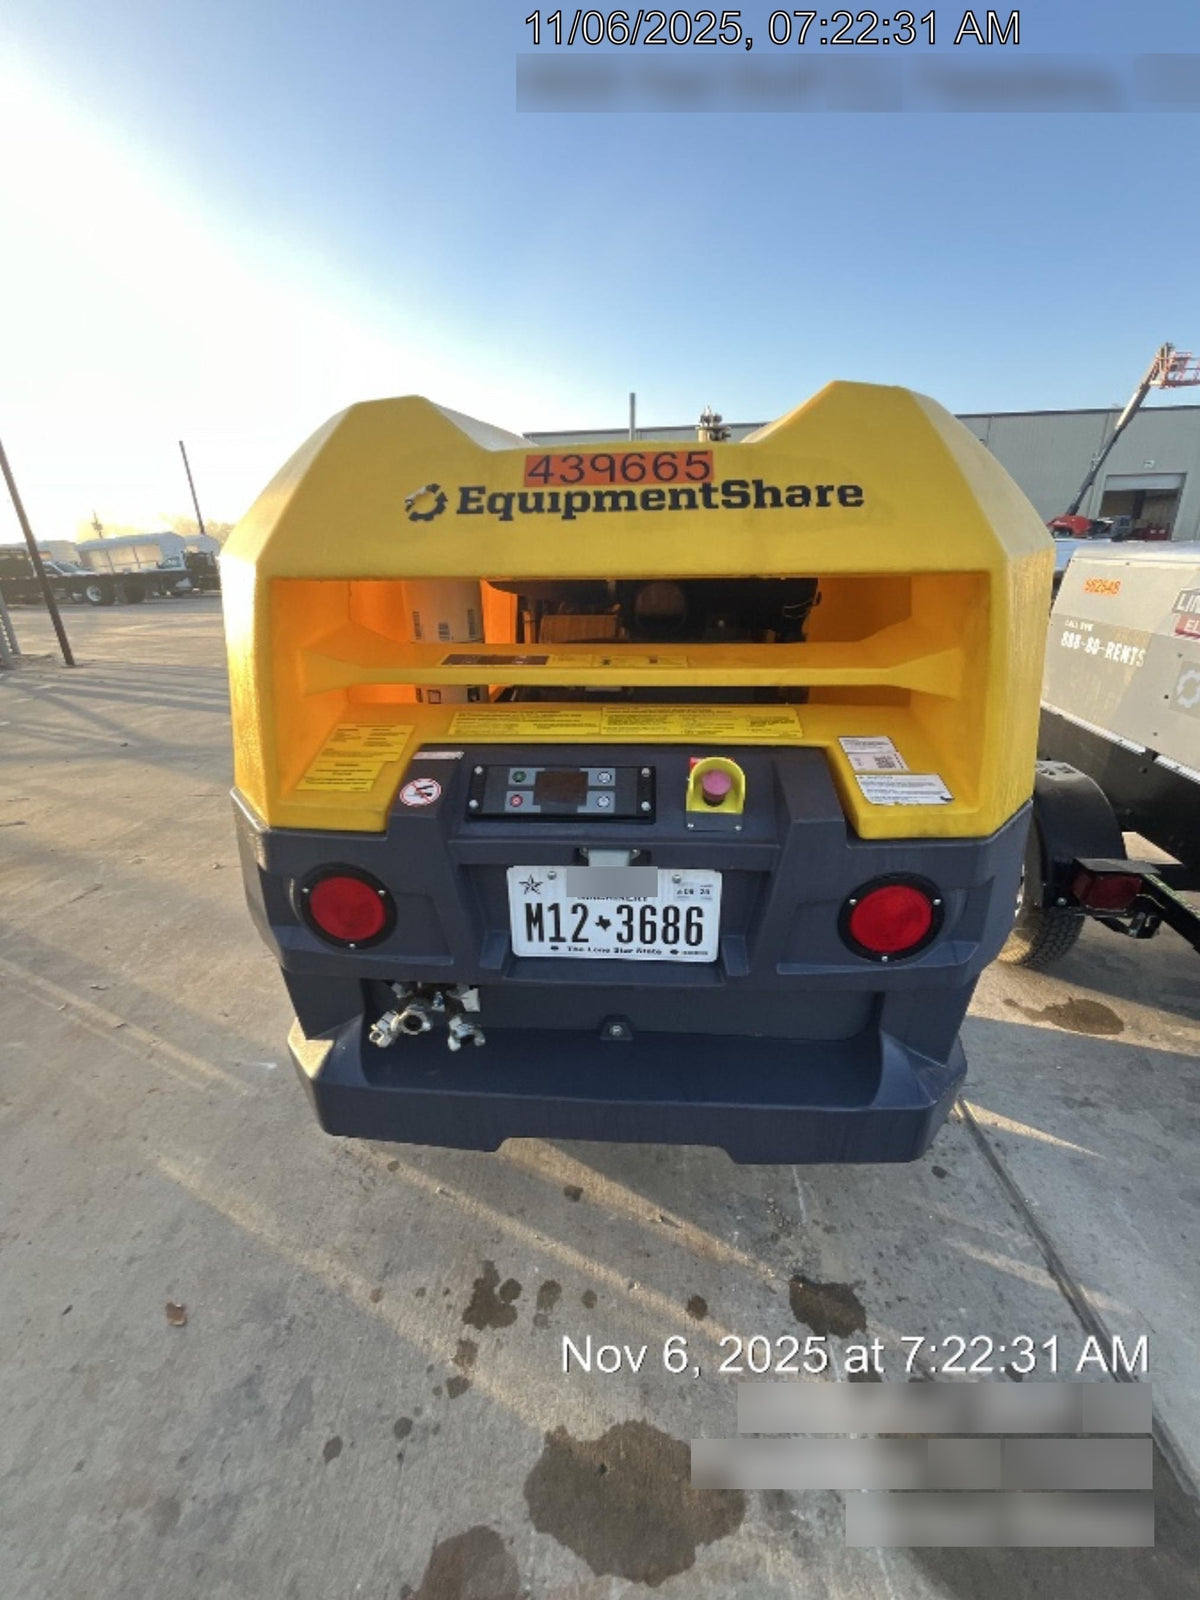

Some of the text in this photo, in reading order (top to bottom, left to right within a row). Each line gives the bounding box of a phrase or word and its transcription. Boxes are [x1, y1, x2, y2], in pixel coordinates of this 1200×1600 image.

[528, 451, 712, 484] 439665
[456, 479, 865, 521] EquipmentShare
[524, 902, 704, 946] M12 3686
